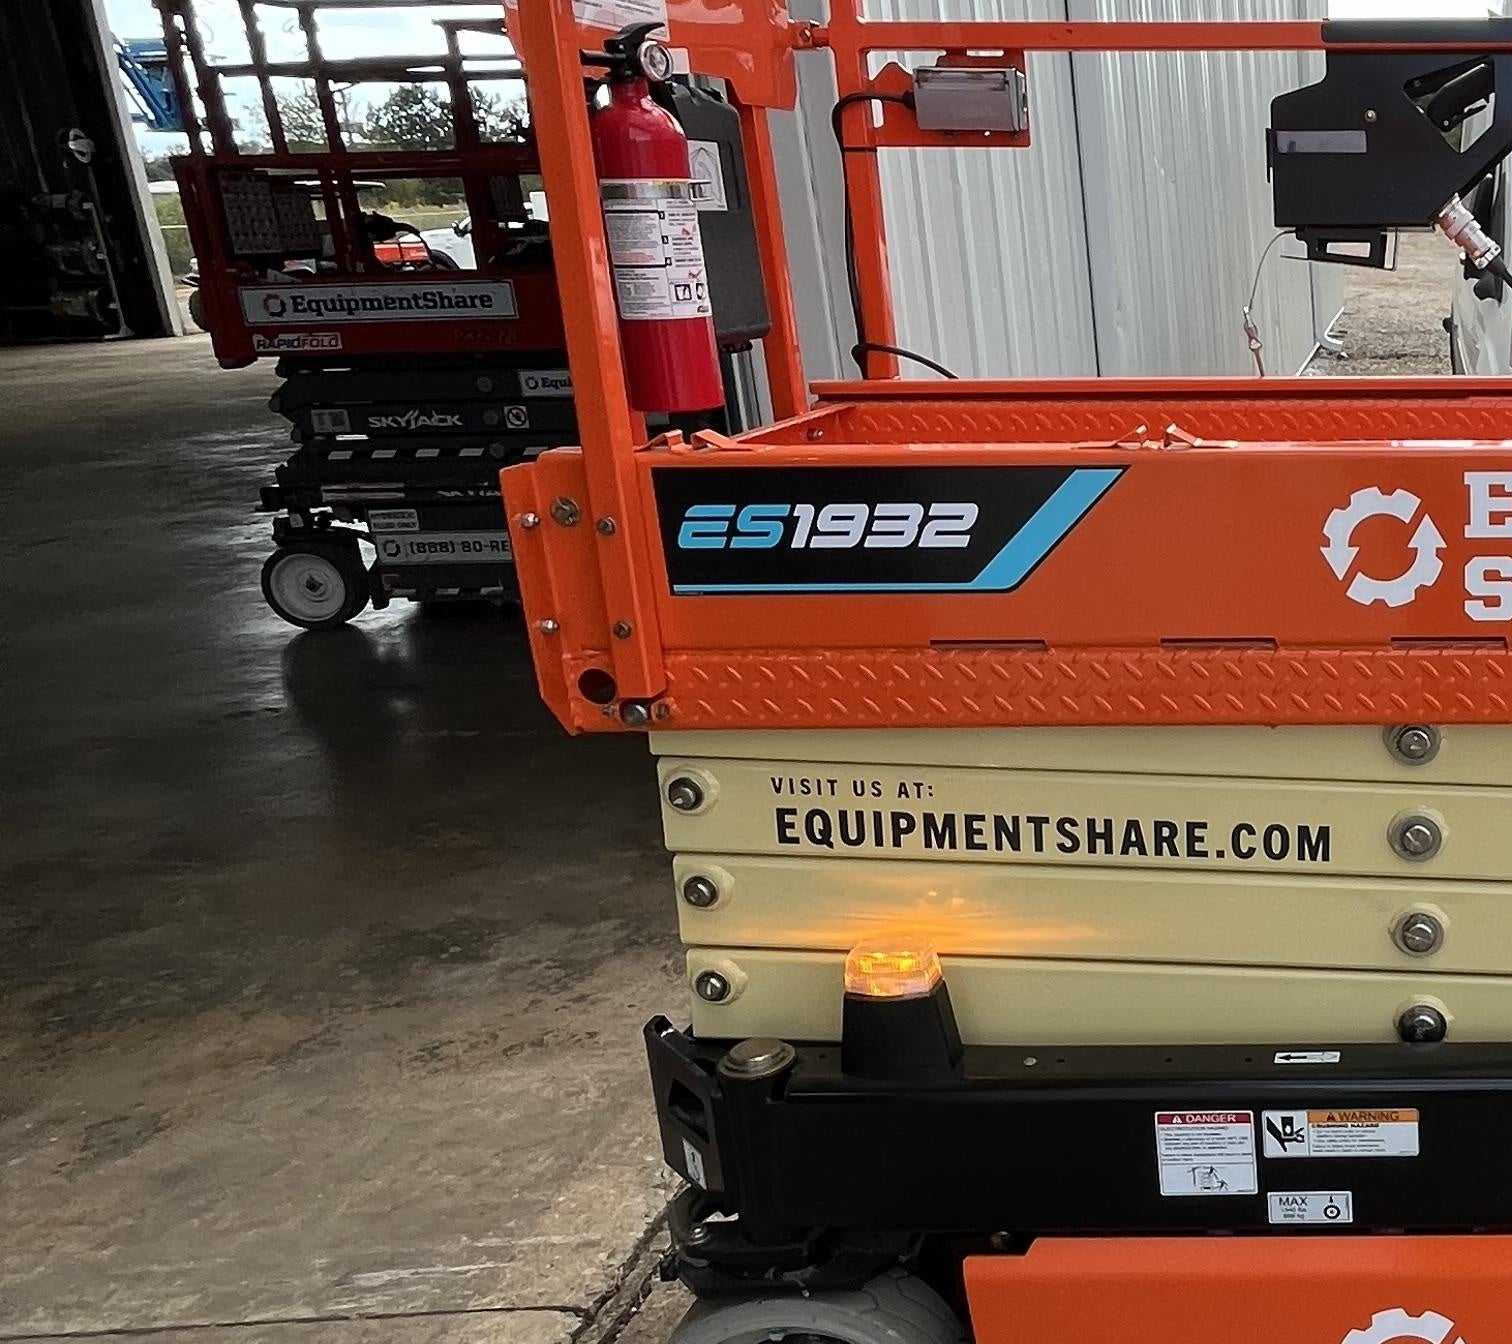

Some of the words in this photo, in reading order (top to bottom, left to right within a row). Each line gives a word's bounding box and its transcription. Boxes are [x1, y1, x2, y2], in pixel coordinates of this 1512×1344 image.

[290, 290, 493, 318] EquipmentShare
[368, 409, 464, 430] SKYJACK
[677, 502, 979, 549] ES1932
[770, 776, 837, 797] VISIT
[852, 779, 884, 798] US
[897, 780, 935, 799] AT:
[775, 806, 1332, 863] EQUIPMENTSHARE.COM
[1185, 1114, 1237, 1123] DANGER
[1338, 1111, 1400, 1122] WARNING
[1279, 1196, 1308, 1206] MAX
